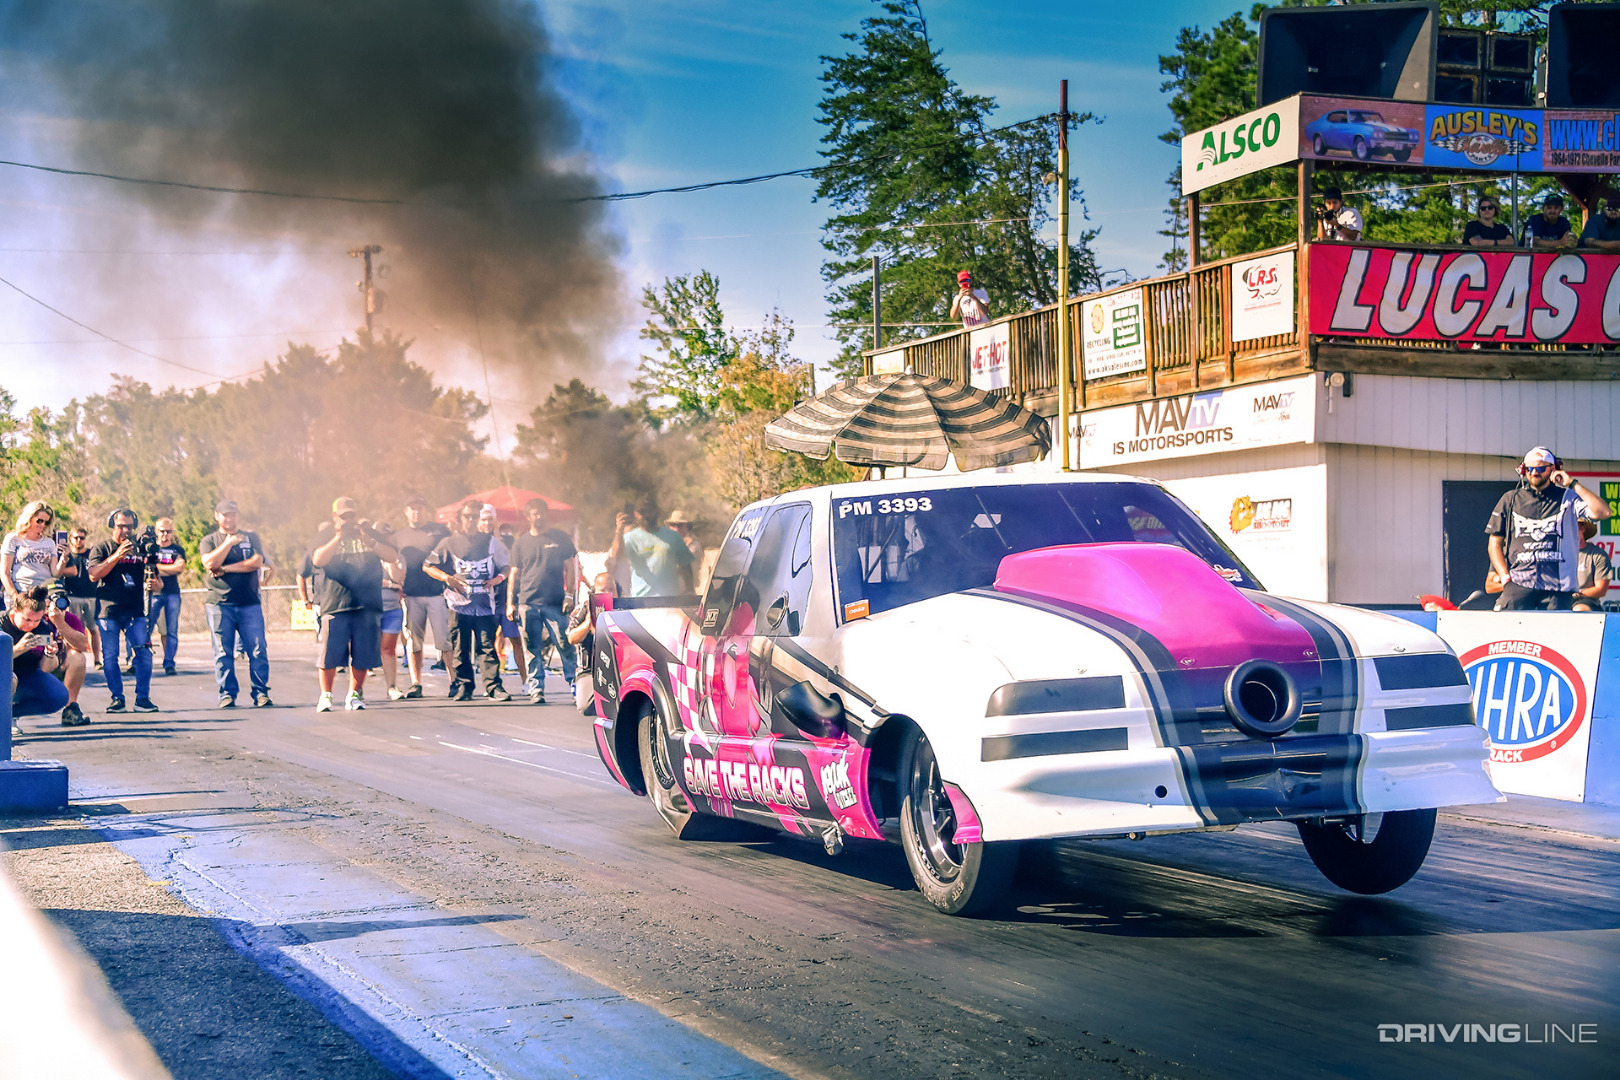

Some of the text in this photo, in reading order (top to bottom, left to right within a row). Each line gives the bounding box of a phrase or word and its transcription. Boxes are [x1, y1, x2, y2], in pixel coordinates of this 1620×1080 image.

[1196, 112, 1281, 172] ALSCO
[1429, 110, 1538, 146] AUSLEY'S
[1551, 152, 1581, 166] 1964-1972
[1328, 248, 1588, 342] LUCAS
[972, 340, 1008, 370] JET-HOT
[1086, 336, 1112, 350] RECYCLING
[1134, 389, 1224, 438] MAVTV
[1112, 442, 1125, 455] IS
[1128, 426, 1234, 454] MOTORSPORTS
[839, 497, 933, 519] PM 3393
[1488, 641, 1542, 656] MEMBER
[1490, 750, 1523, 762] RACK
[683, 757, 723, 798] SAVE
[719, 760, 754, 802] THE
[749, 763, 810, 810] RACKS
